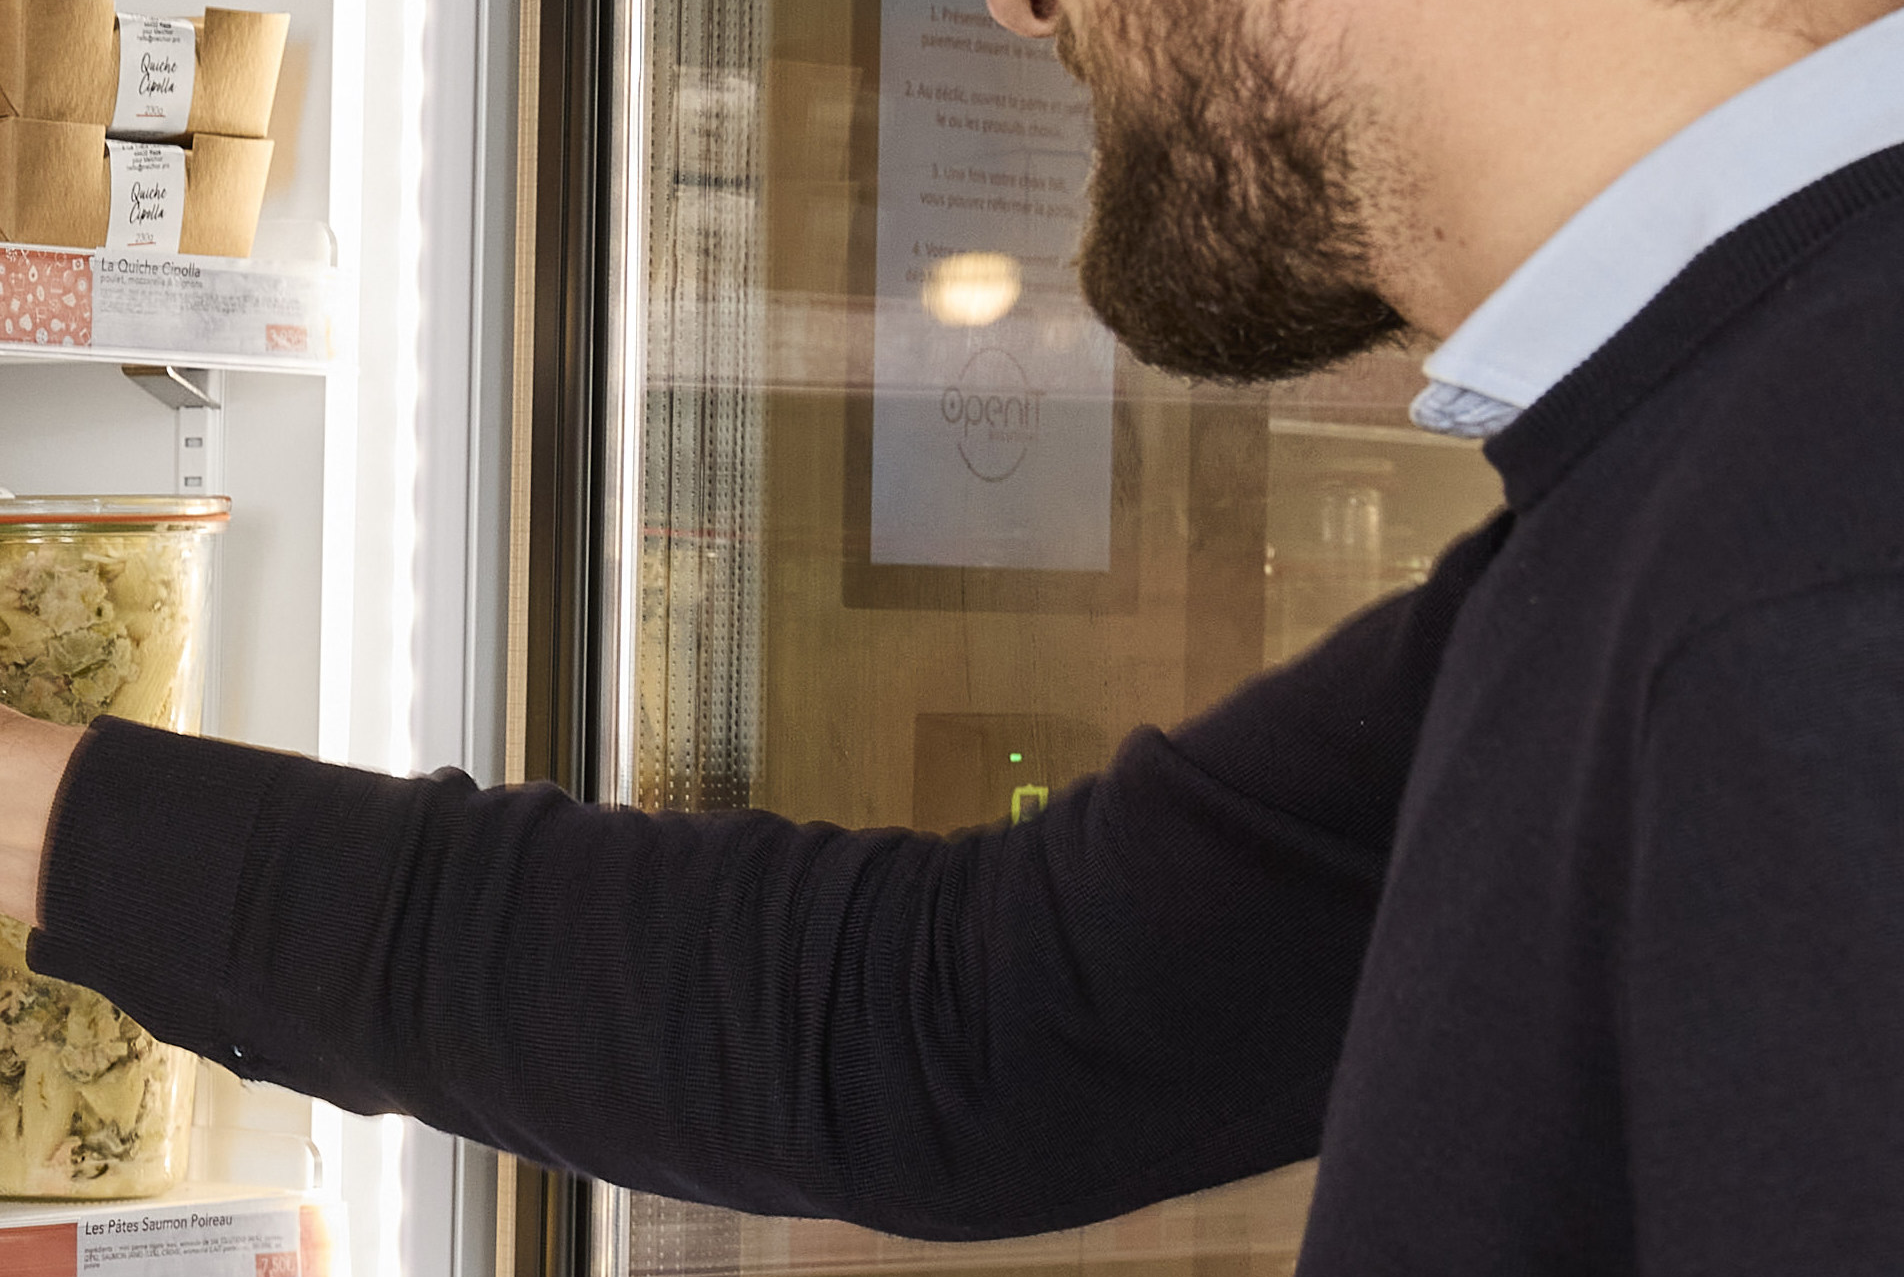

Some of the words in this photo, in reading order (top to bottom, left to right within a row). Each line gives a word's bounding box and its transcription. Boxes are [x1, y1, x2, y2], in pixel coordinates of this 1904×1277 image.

[141, 53, 177, 80] Quiche
[139, 74, 174, 97] Cipolla
[131, 182, 166, 210] Quiche
[129, 203, 164, 224] Cipolla
[101, 257, 114, 273] La
[118, 259, 159, 275] Quiche
[85, 1221, 104, 1236] Les
[108, 1219, 138, 1234] Pâtes
[142, 1216, 188, 1231] Saumon
[191, 1214, 232, 1229] Poireau
